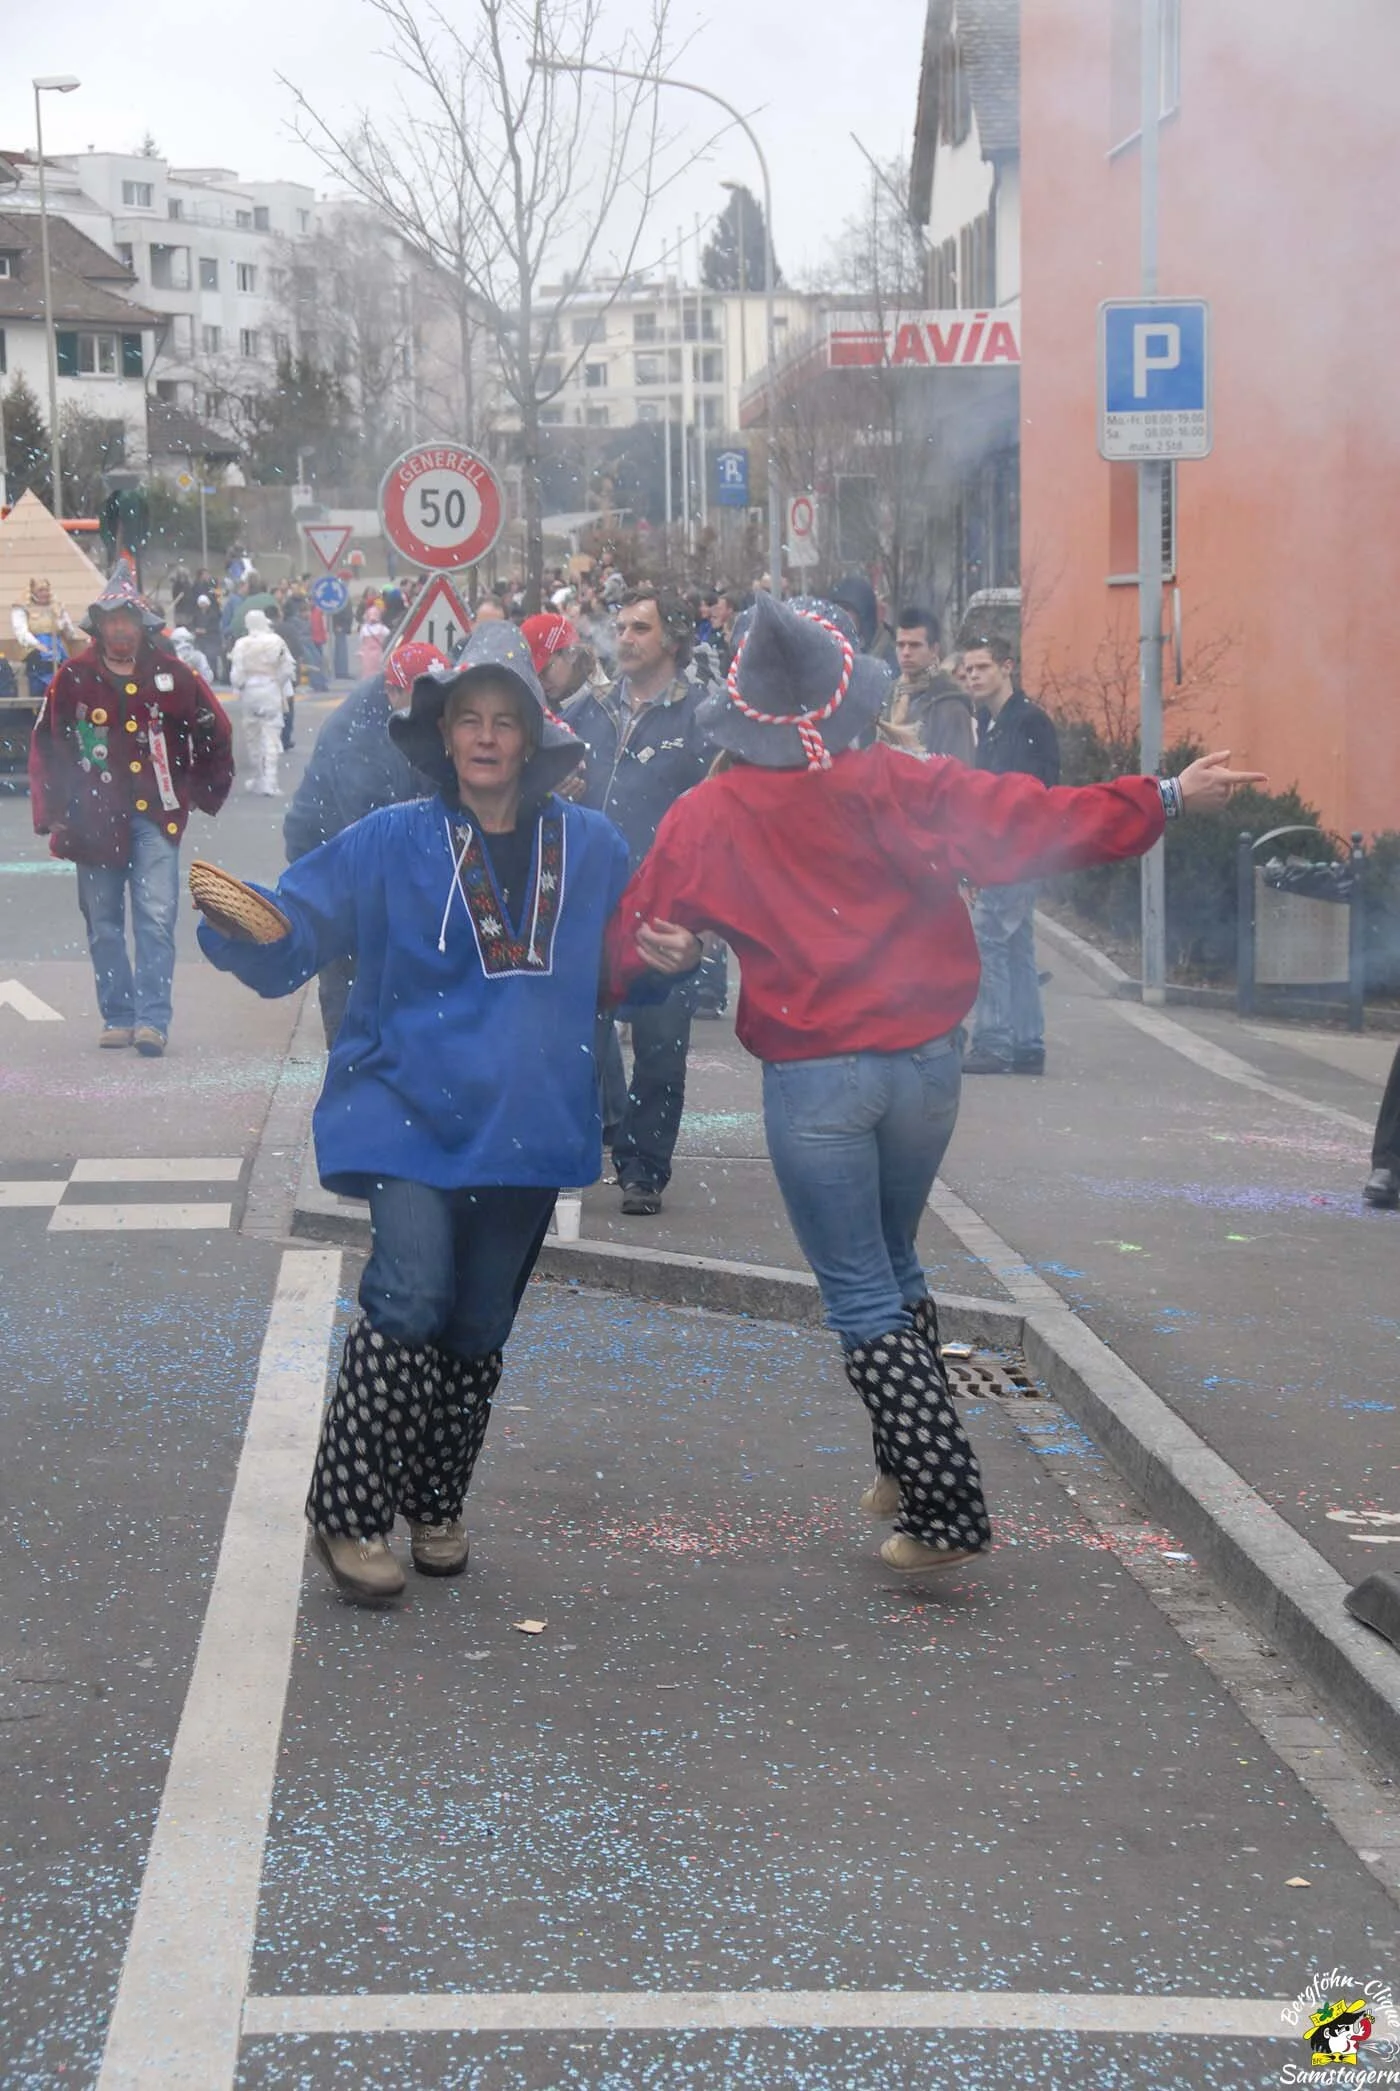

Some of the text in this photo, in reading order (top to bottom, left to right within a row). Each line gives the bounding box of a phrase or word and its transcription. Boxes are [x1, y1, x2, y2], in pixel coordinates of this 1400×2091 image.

[1133, 323, 1180, 398] P
[1157, 440, 1164, 451] 2
[398, 451, 485, 487] GENERELL
[420, 487, 466, 529] 50
